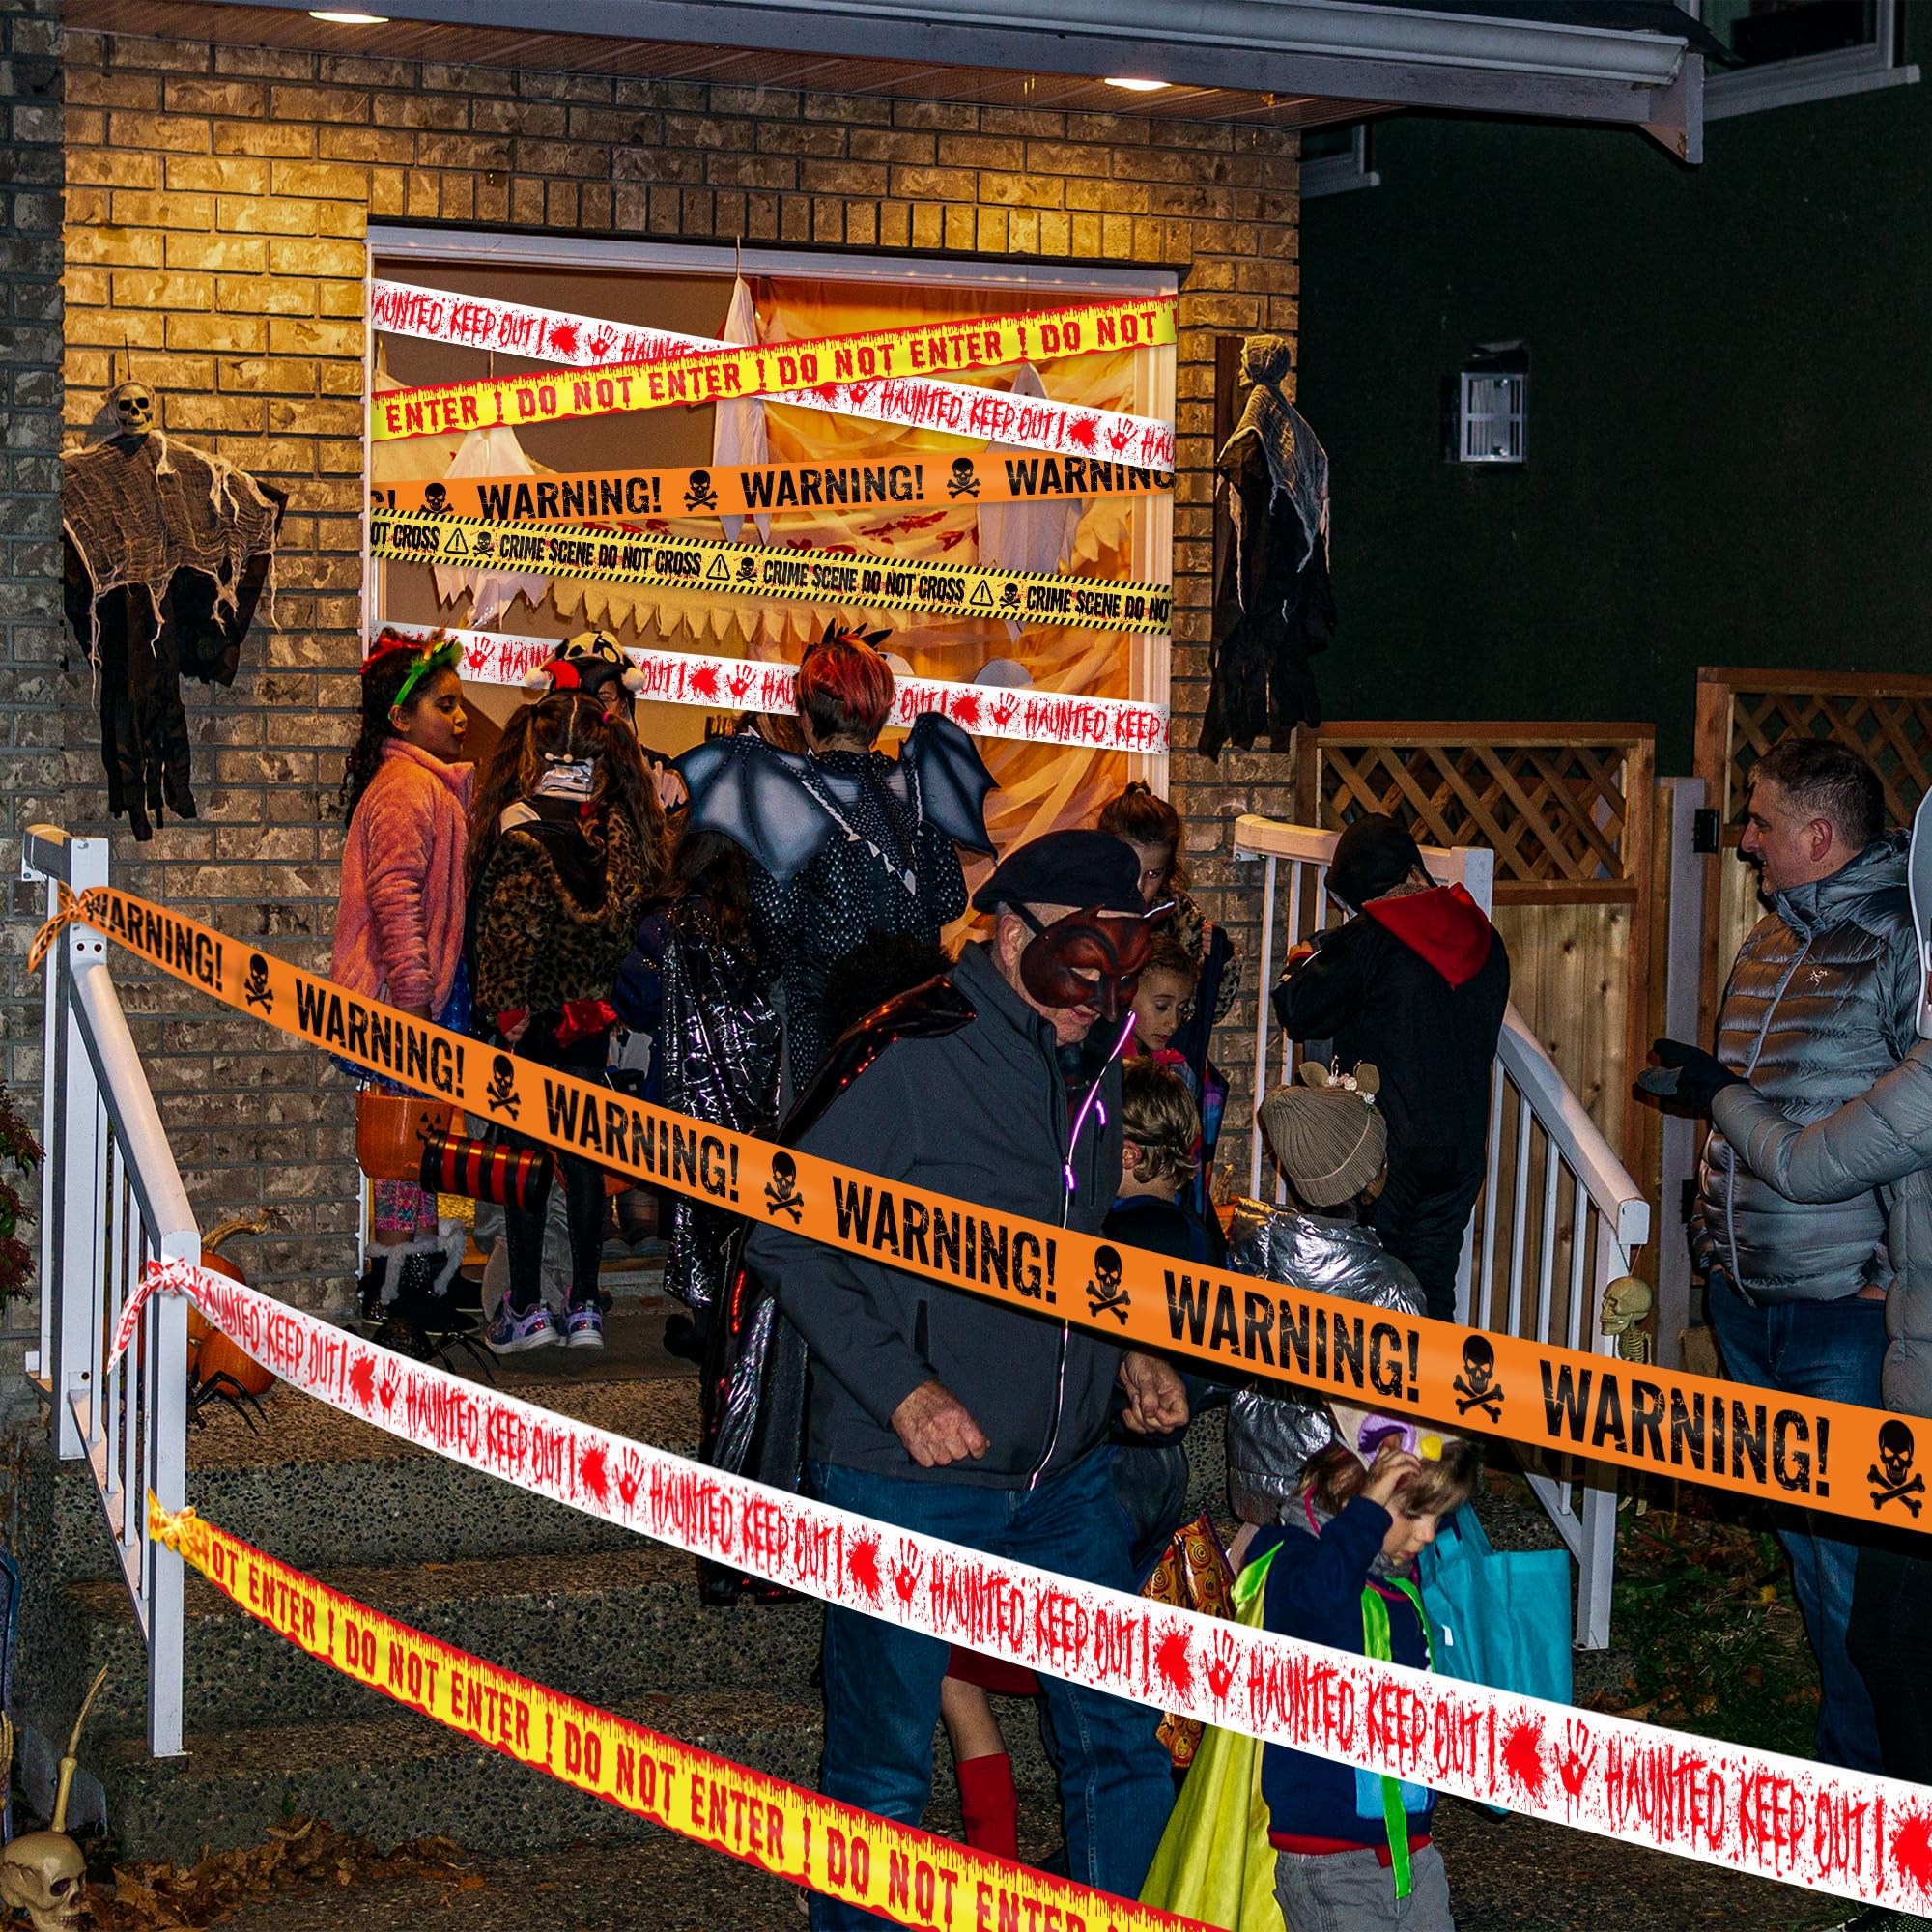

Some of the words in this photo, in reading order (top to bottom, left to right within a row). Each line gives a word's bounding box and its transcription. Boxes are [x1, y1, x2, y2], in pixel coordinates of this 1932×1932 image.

[385, 391, 479, 433] ENTER
[518, 385, 557, 418] DO
[574, 375, 633, 413] NOT
[648, 363, 742, 401] ENTER
[778, 354, 818, 386] DO
[835, 344, 895, 380] NOT
[910, 329, 1004, 369] ENTER
[1041, 322, 1081, 352] DO
[1096, 310, 1157, 347] NOT
[449, 302, 497, 345] KEEP
[880, 380, 964, 431] HAUNTED
[968, 394, 1015, 442] KEEP
[477, 476, 661, 522] WARNING!
[740, 465, 924, 508] WARNING!
[370, 522, 391, 548] OT
[393, 524, 440, 553] CROSS
[499, 534, 545, 563] CRIME
[548, 539, 594, 570] SCENE
[598, 544, 618, 570] DO
[622, 547, 653, 572] NOT
[656, 549, 701, 578] CROSS
[764, 560, 810, 589] CRIME
[812, 565, 859, 595] SCENE
[862, 571, 883, 596] DO
[886, 573, 917, 599] NOT
[920, 576, 966, 606] CROSS
[1027, 585, 1072, 613] CRIME
[1075, 589, 1122, 619] SCENE
[1124, 595, 1145, 621] DO
[1149, 597, 1173, 624] NO
[1024, 697, 1108, 744] HAUNTED
[1115, 709, 1161, 751] KEEP
[296, 978, 466, 1099] WARNING!
[544, 1078, 740, 1203] WARNING!
[832, 1175, 1058, 1305] WARNING!
[1163, 1268, 1421, 1404] WARNING!
[1539, 1358, 1831, 1499] WARNING!
[266, 1309, 305, 1373] KEEP
[406, 1369, 479, 1458] HAUNTED
[486, 1408, 529, 1473] KEEP
[650, 1464, 734, 1551] HAUNTED
[742, 1494, 790, 1575] KEEP
[929, 1551, 1025, 1653] HAUNTED
[1034, 1589, 1090, 1676] KEEP
[1248, 1642, 1355, 1751] HAUNTED
[1367, 1678, 1427, 1776] KEEP
[1605, 1731, 1726, 1850] HAUNTED
[1739, 1767, 1806, 1875] KEEP
[212, 1540, 239, 1593] OT
[248, 1562, 316, 1647] ENTER
[345, 1618, 377, 1678] DO
[388, 1640, 440, 1711] NOT
[450, 1673, 530, 1755] ENTER
[564, 1720, 602, 1786] DO
[616, 1743, 676, 1820] NOT
[690, 1773, 785, 1867] ENTER
[826, 1826, 871, 1900] DO
[889, 1849, 959, 1930] NOT
